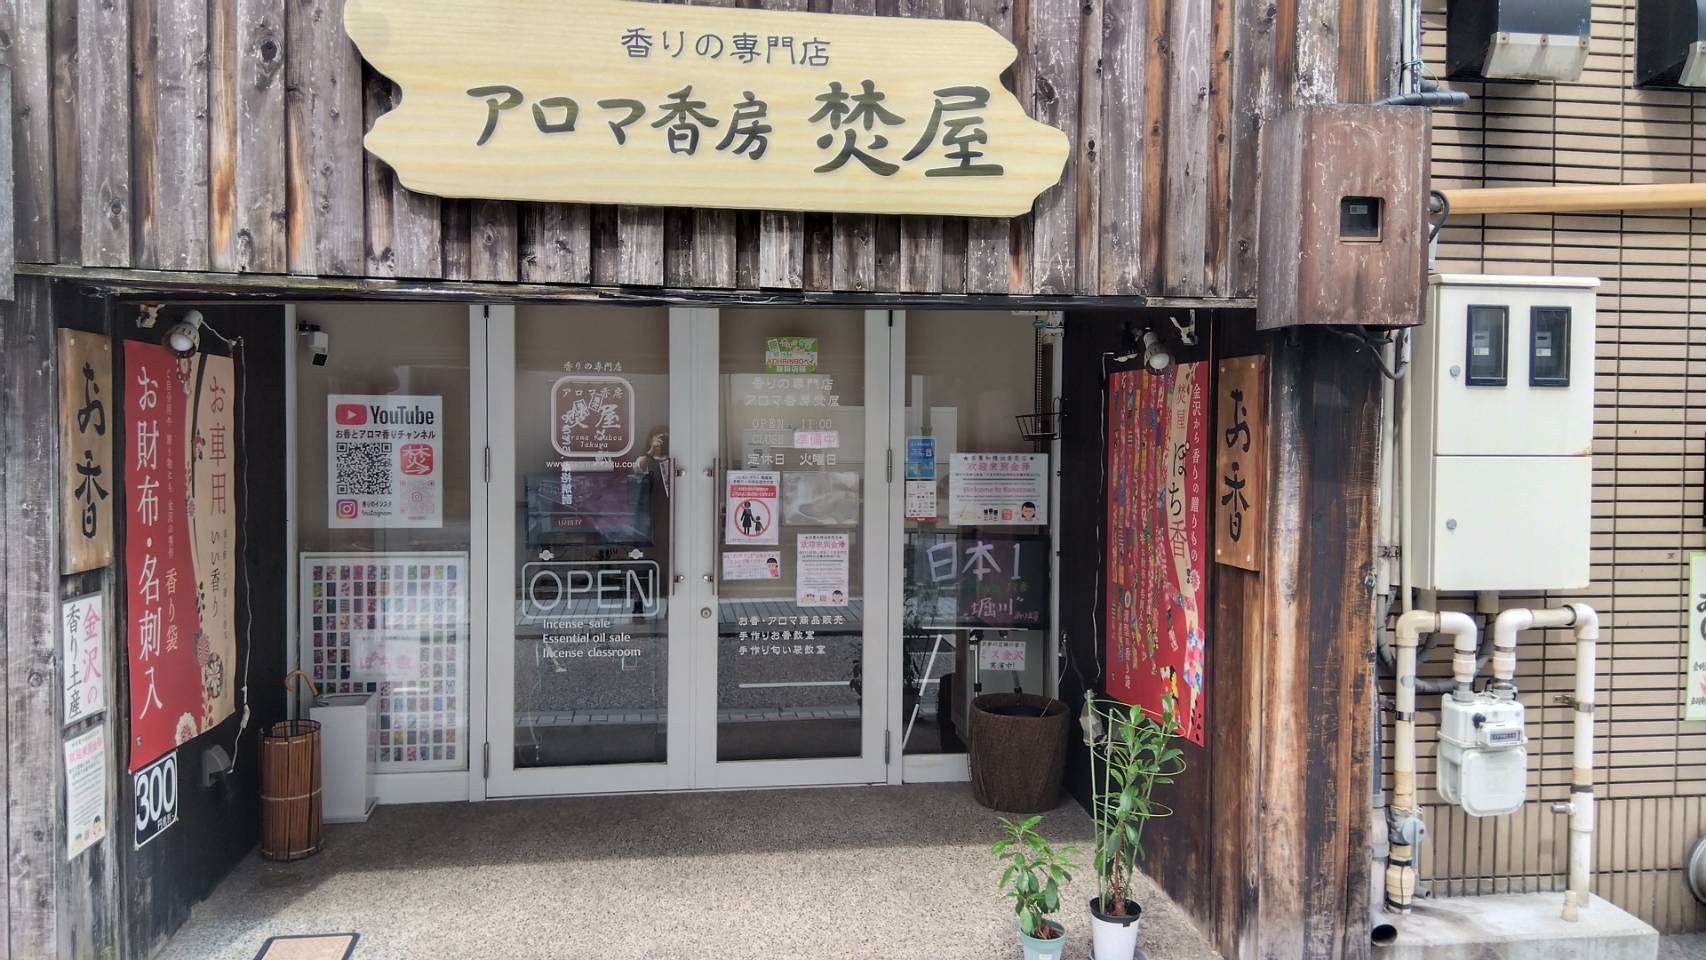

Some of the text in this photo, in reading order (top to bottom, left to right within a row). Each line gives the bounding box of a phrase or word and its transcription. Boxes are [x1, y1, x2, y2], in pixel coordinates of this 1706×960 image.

[620, 27, 832, 67] 香りの専門店
[466, 79, 1004, 178] アロマ香房 焚屋
[563, 361, 623, 372] 香りの専門店
[751, 376, 834, 391] 香りの専門店
[369, 405, 435, 426] YouTube
[75, 360, 109, 539] お香
[209, 375, 226, 516] お車用
[747, 452, 836, 466] 定休日 火曜日
[1221, 389, 1251, 542] お香
[136, 366, 163, 720] お財布・名刺入
[529, 569, 654, 611] OPEN
[542, 632, 631, 644] Essential oil sale
[543, 619, 611, 629] Incense sale
[66, 602, 83, 720] 香り土産
[82, 603, 102, 705] 金沢の
[587, 647, 641, 658] classroom
[136, 758, 176, 831] 300
